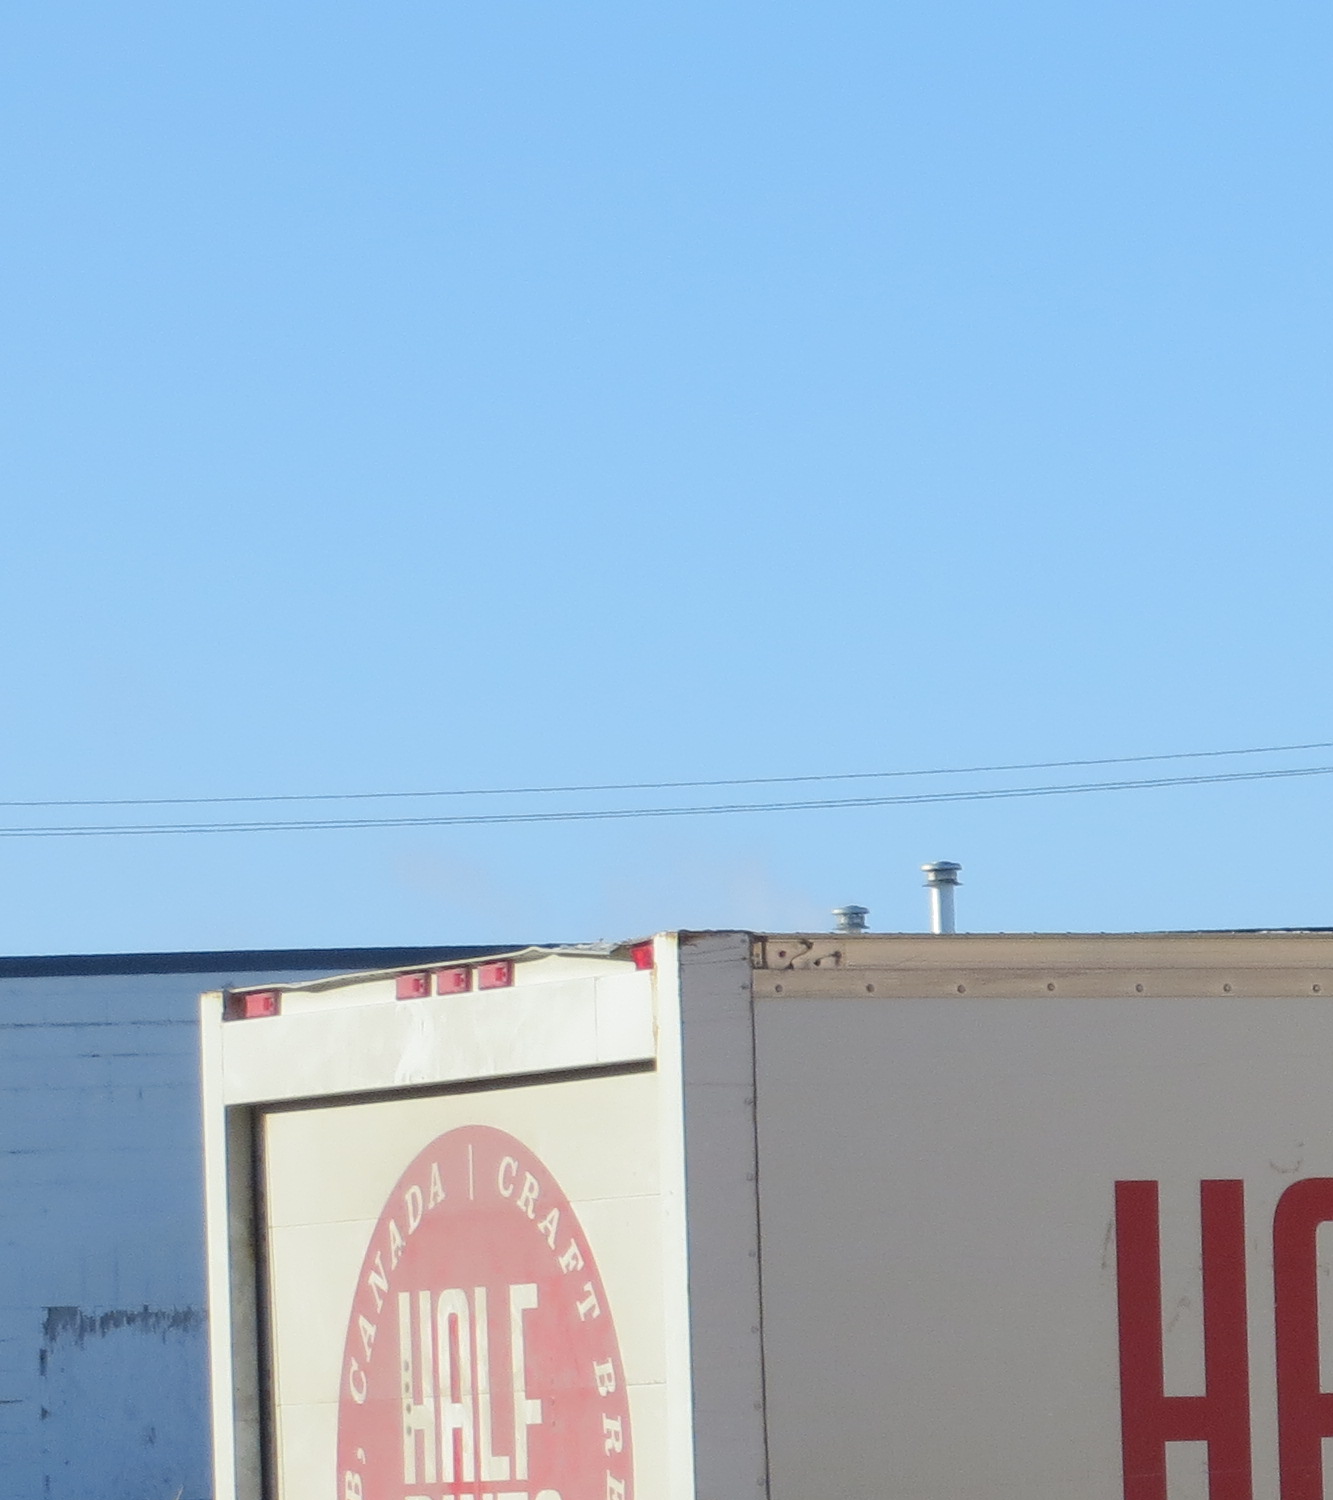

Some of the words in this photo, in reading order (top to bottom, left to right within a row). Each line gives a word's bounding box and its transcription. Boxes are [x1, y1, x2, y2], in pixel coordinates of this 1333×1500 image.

[349, 1162, 446, 1404] CANADA
[498, 1155, 601, 1321] CRAFT
[397, 1282, 545, 1484] HALF
